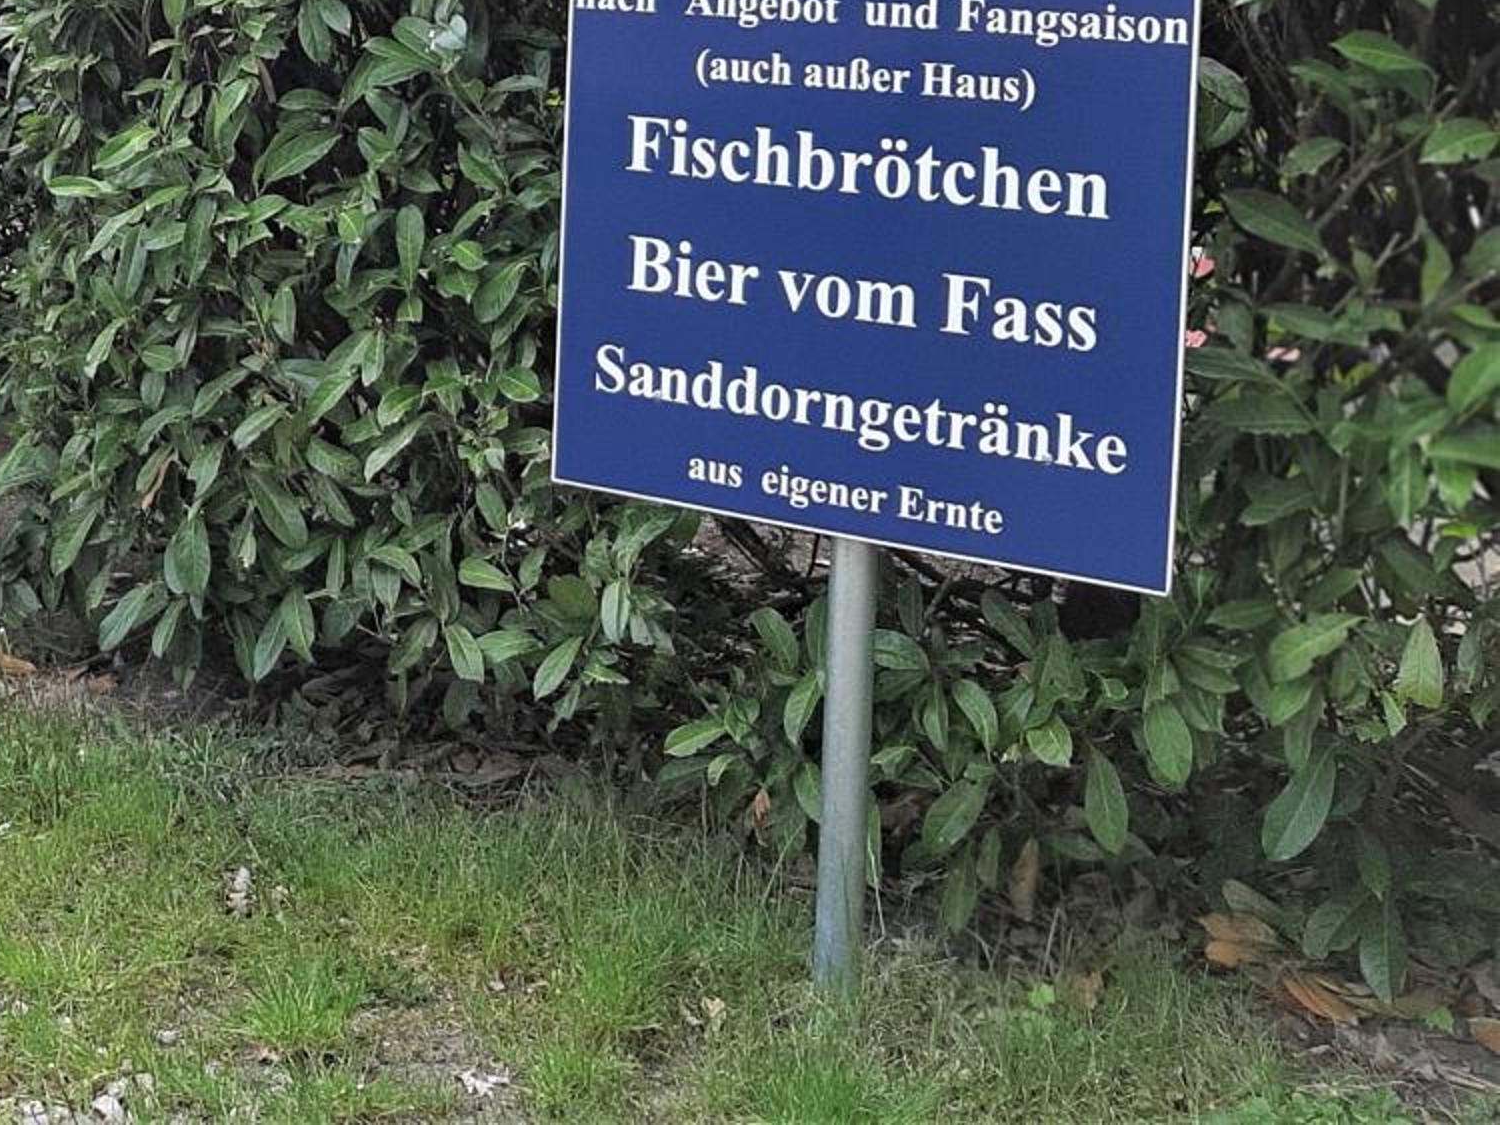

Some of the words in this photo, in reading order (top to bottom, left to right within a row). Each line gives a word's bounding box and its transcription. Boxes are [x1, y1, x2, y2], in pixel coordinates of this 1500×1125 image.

[697, 49, 791, 87] (auch
[804, 58, 910, 93] außer
[922, 63, 1034, 110] Haus)
[626, 116, 1108, 219] Fischbrötchen
[628, 236, 759, 304] Bier
[778, 271, 916, 327] vom
[940, 274, 1096, 351] Fass
[595, 345, 1128, 474] Sanddorngetränke
[689, 459, 742, 487] aus
[762, 472, 887, 509] eigener
[898, 486, 1002, 533] Ernte
